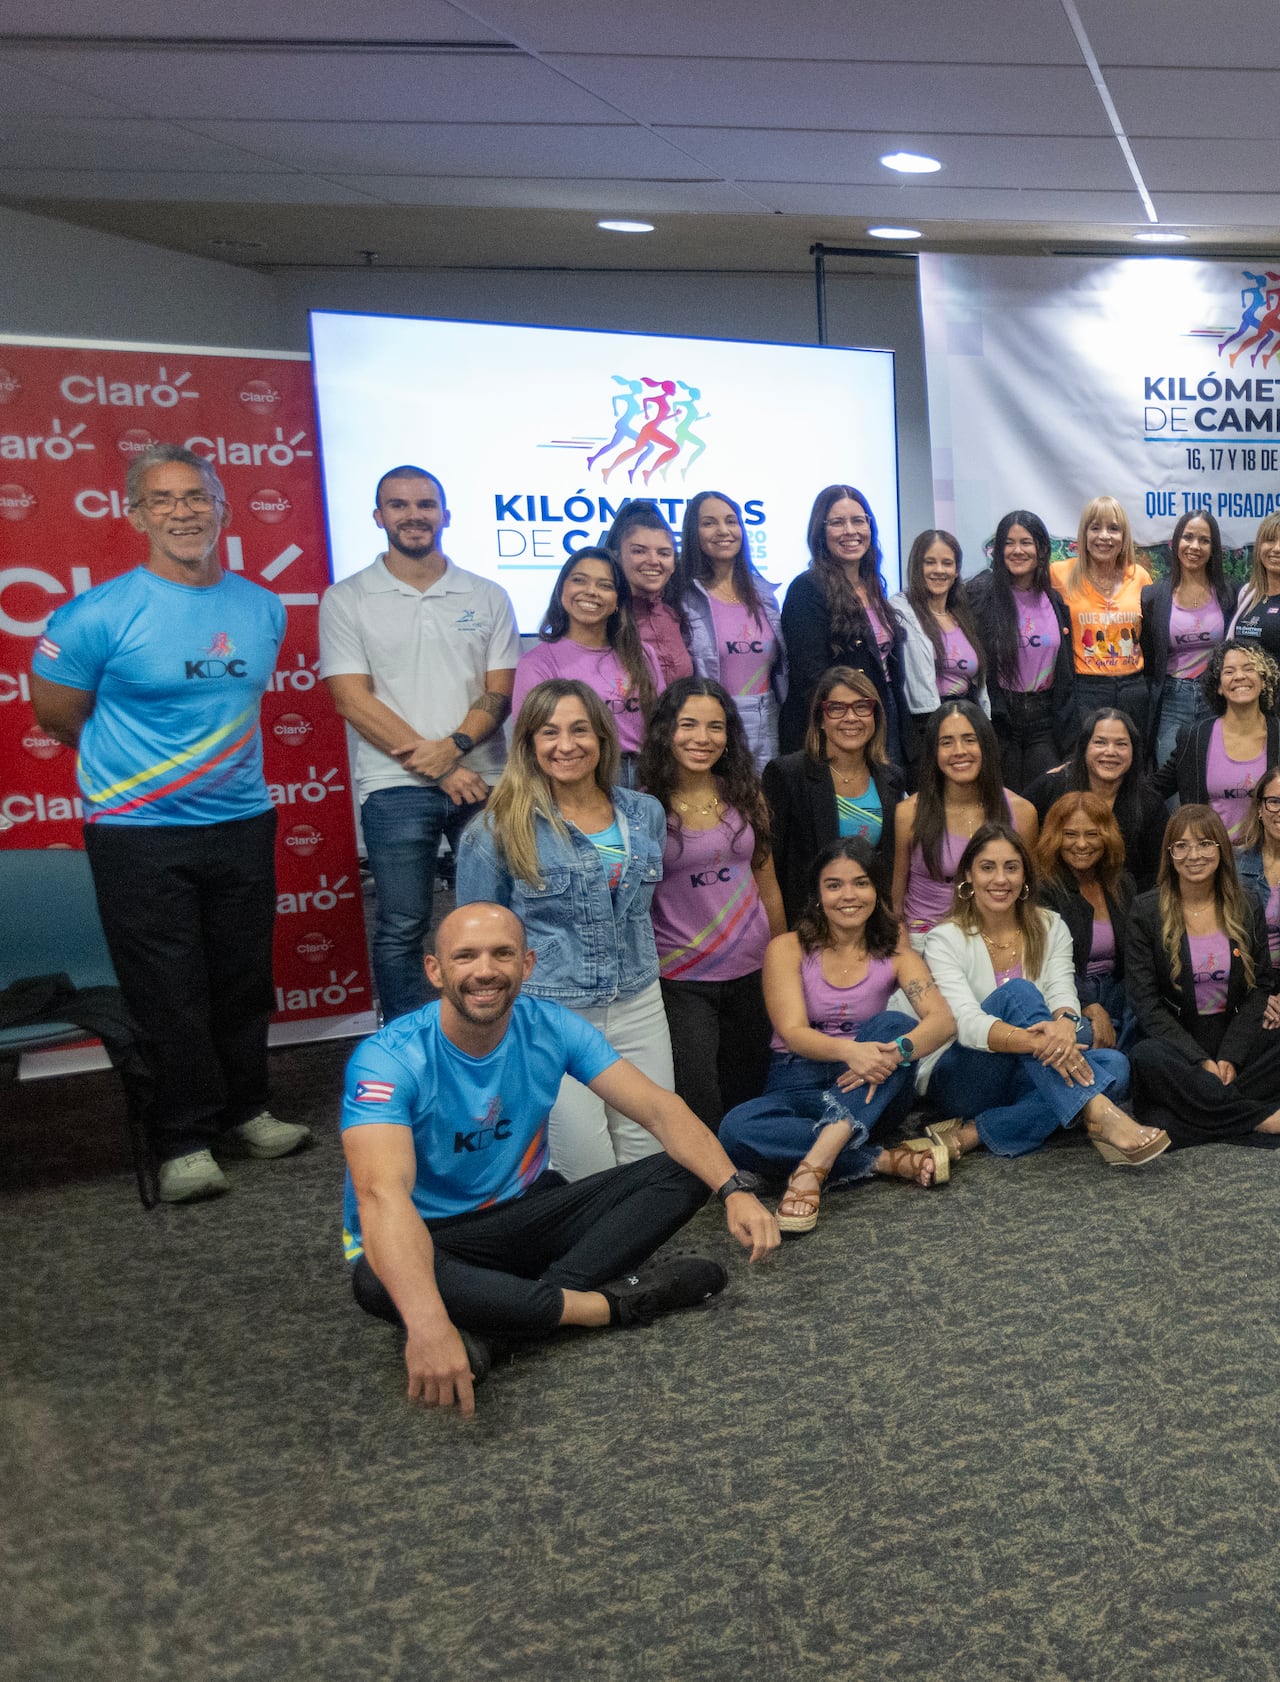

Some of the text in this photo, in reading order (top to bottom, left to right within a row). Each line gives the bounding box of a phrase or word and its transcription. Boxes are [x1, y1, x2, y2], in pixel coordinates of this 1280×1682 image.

[60, 374, 180, 408] Claro
[239, 391, 277, 403] Claro
[1144, 407, 1188, 432] DE
[0, 434, 74, 461] aro
[1186, 448, 1205, 472] 16,
[1210, 449, 1223, 471] 17
[1228, 450, 1237, 470] Y
[1241, 449, 1256, 471] 18
[1261, 449, 1279, 471] DE
[252, 500, 285, 512] Claro
[1146, 492, 1176, 518] QUE
[1182, 492, 1212, 512] TUS
[496, 529, 555, 558] DE
[726, 641, 763, 654] KDC
[1175, 632, 1211, 644] KDC
[186, 659, 248, 680] KDC
[274, 724, 307, 736] Claro
[268, 781, 327, 805] aro
[285, 835, 318, 847] Claro
[690, 867, 731, 888] KDC
[277, 889, 339, 914] aro
[296, 943, 328, 953] Claro
[277, 984, 348, 1012] laro
[454, 1119, 514, 1153] KDC
